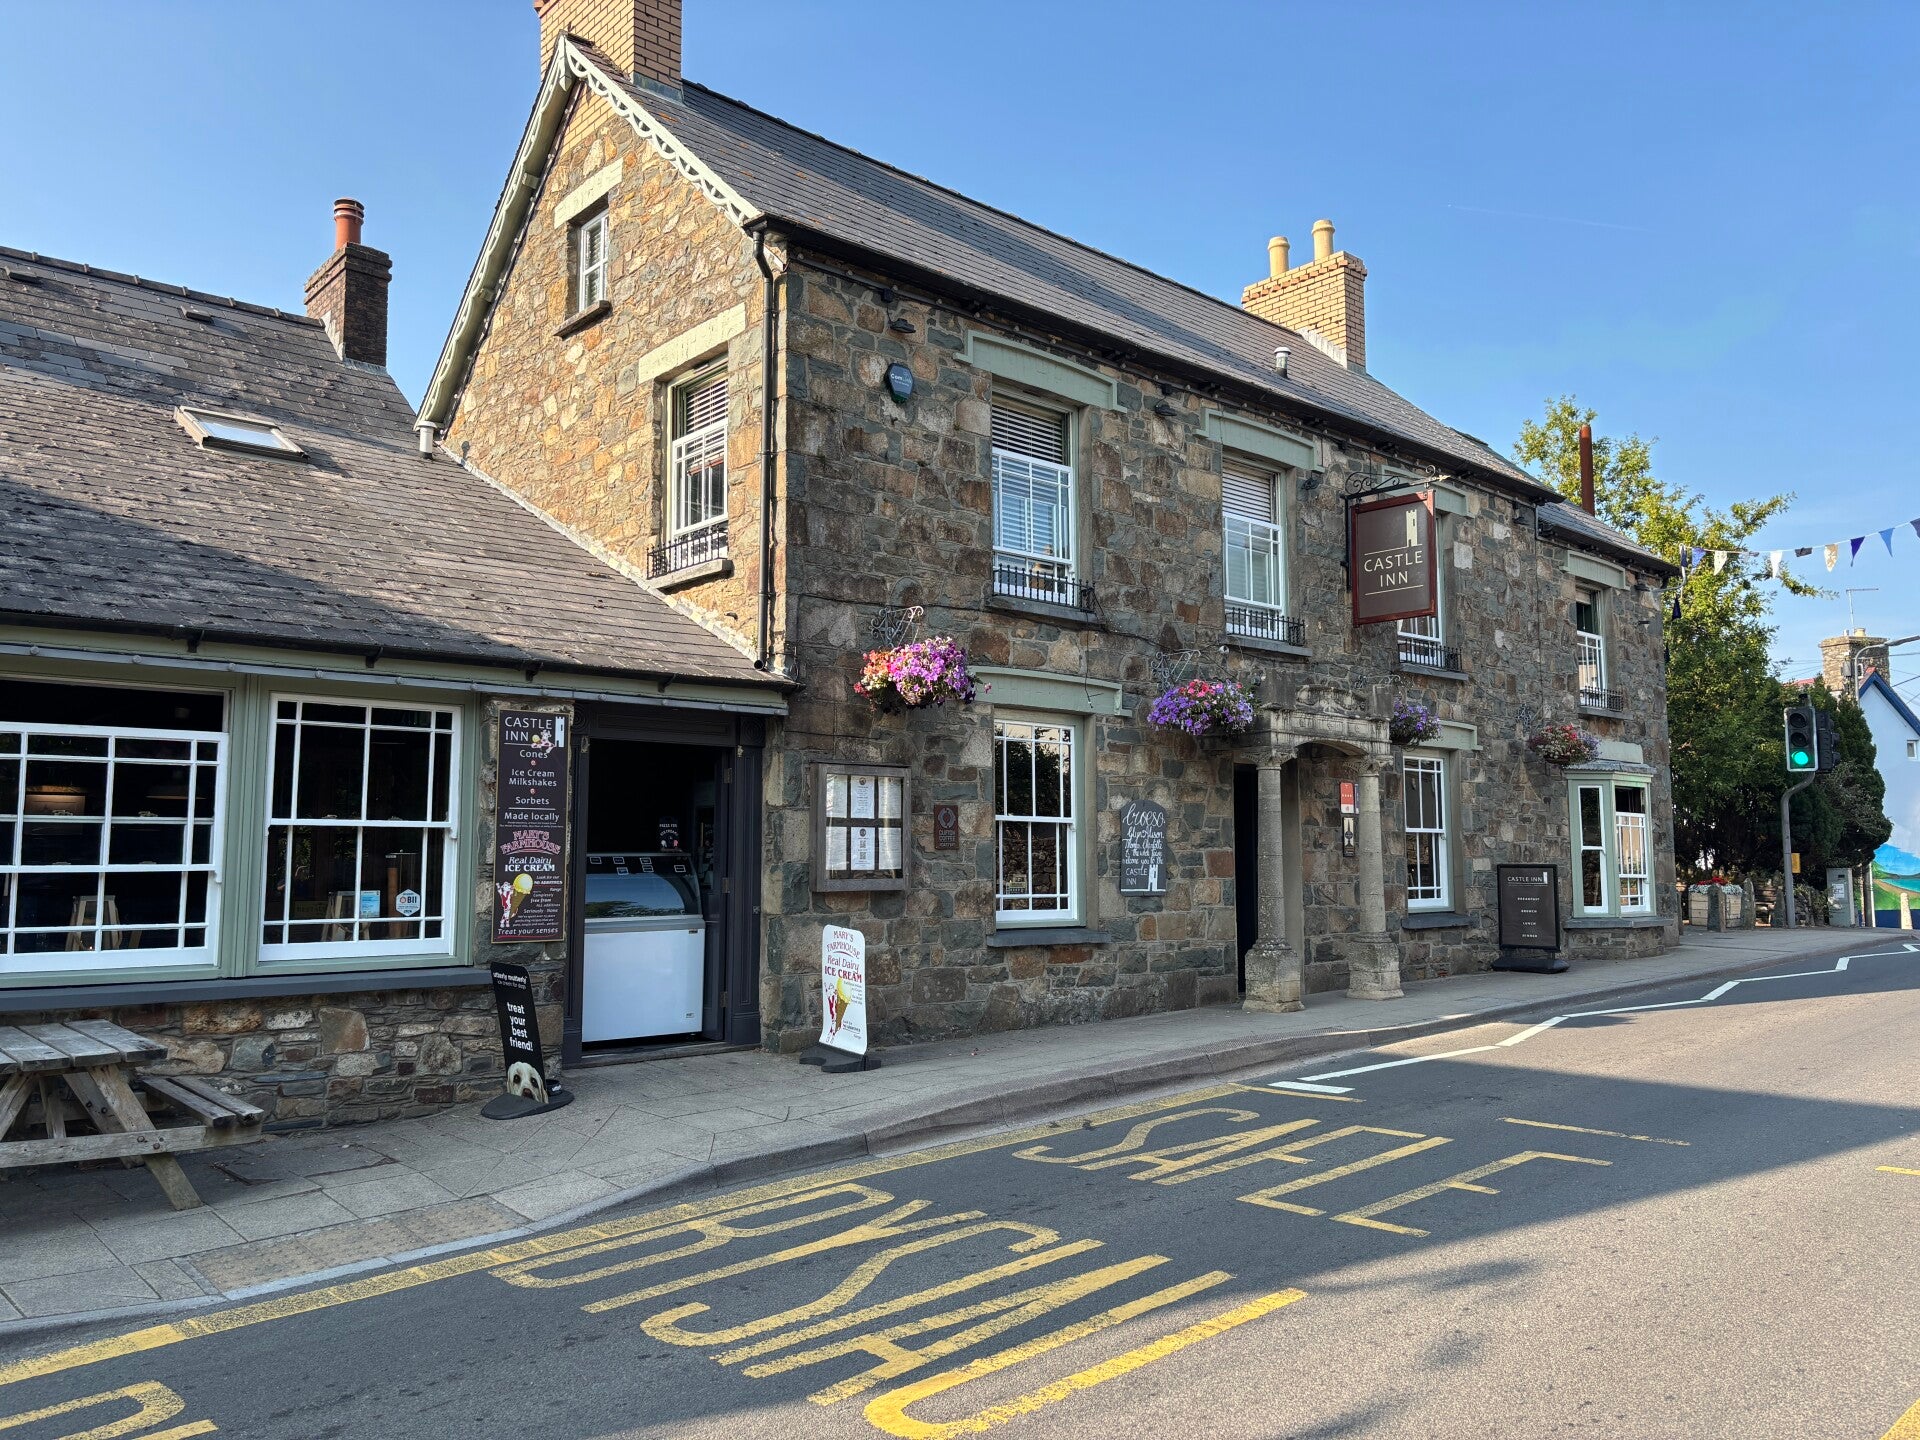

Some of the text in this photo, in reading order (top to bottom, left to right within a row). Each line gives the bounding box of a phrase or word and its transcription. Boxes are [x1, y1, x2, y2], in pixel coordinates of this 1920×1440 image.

[1365, 551, 1423, 572] CASTLE
[1381, 571, 1409, 588] INN
[505, 717, 552, 730] CASTLE
[506, 731, 529, 742] INN
[520, 749, 548, 759] Cones
[512, 768, 555, 778] Ice Cream
[509, 778, 557, 788] Milkshakes
[516, 796, 549, 805] Sorbets
[505, 811, 529, 820] Made
[532, 813, 560, 823] locally
[513, 830, 549, 841] MARY'S
[500, 839, 561, 855] FARMHOUSE
[509, 856, 552, 866] Real Dairy
[505, 864, 555, 872] ICE CREAM
[1126, 867, 1148, 876] CASTLE
[1126, 877, 1137, 886] INN
[498, 927, 559, 937] Treat your senses
[834, 931, 854, 943] MARY'S
[827, 942, 860, 960] FARMHOUSE
[828, 955, 860, 975] Real Dairy
[824, 966, 837, 977] ICE
[838, 969, 863, 984] CREAM
[507, 1002, 525, 1015] treat
[510, 1016, 526, 1027] your
[512, 1026, 528, 1039] best
[510, 1037, 534, 1052] friend!
[1011, 1106, 1613, 1238] SAFLE
[489, 1182, 1309, 1440] BYSIAU
